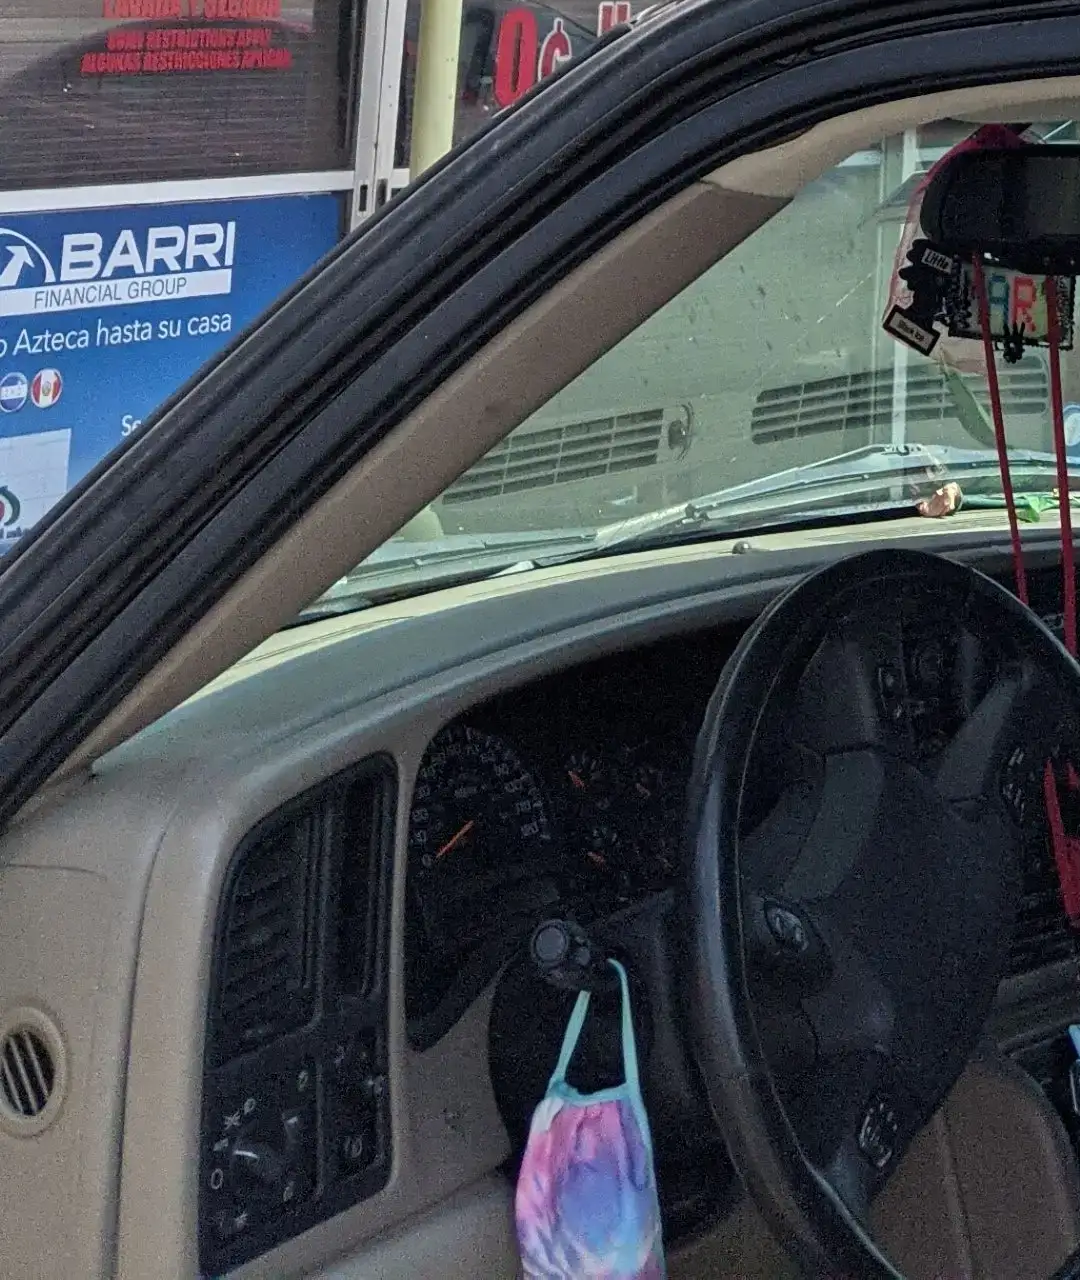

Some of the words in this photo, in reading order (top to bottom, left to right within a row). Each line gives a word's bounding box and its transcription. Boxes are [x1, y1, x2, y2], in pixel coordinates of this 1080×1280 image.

[60, 221, 236, 282] BARRI
[33, 284, 122, 310] FINANCIAL
[127, 276, 188, 297] GROUP
[12, 328, 89, 357] Azteca
[96, 318, 152, 348] hasta
[158, 319, 181, 339] su
[187, 312, 232, 336] casa
